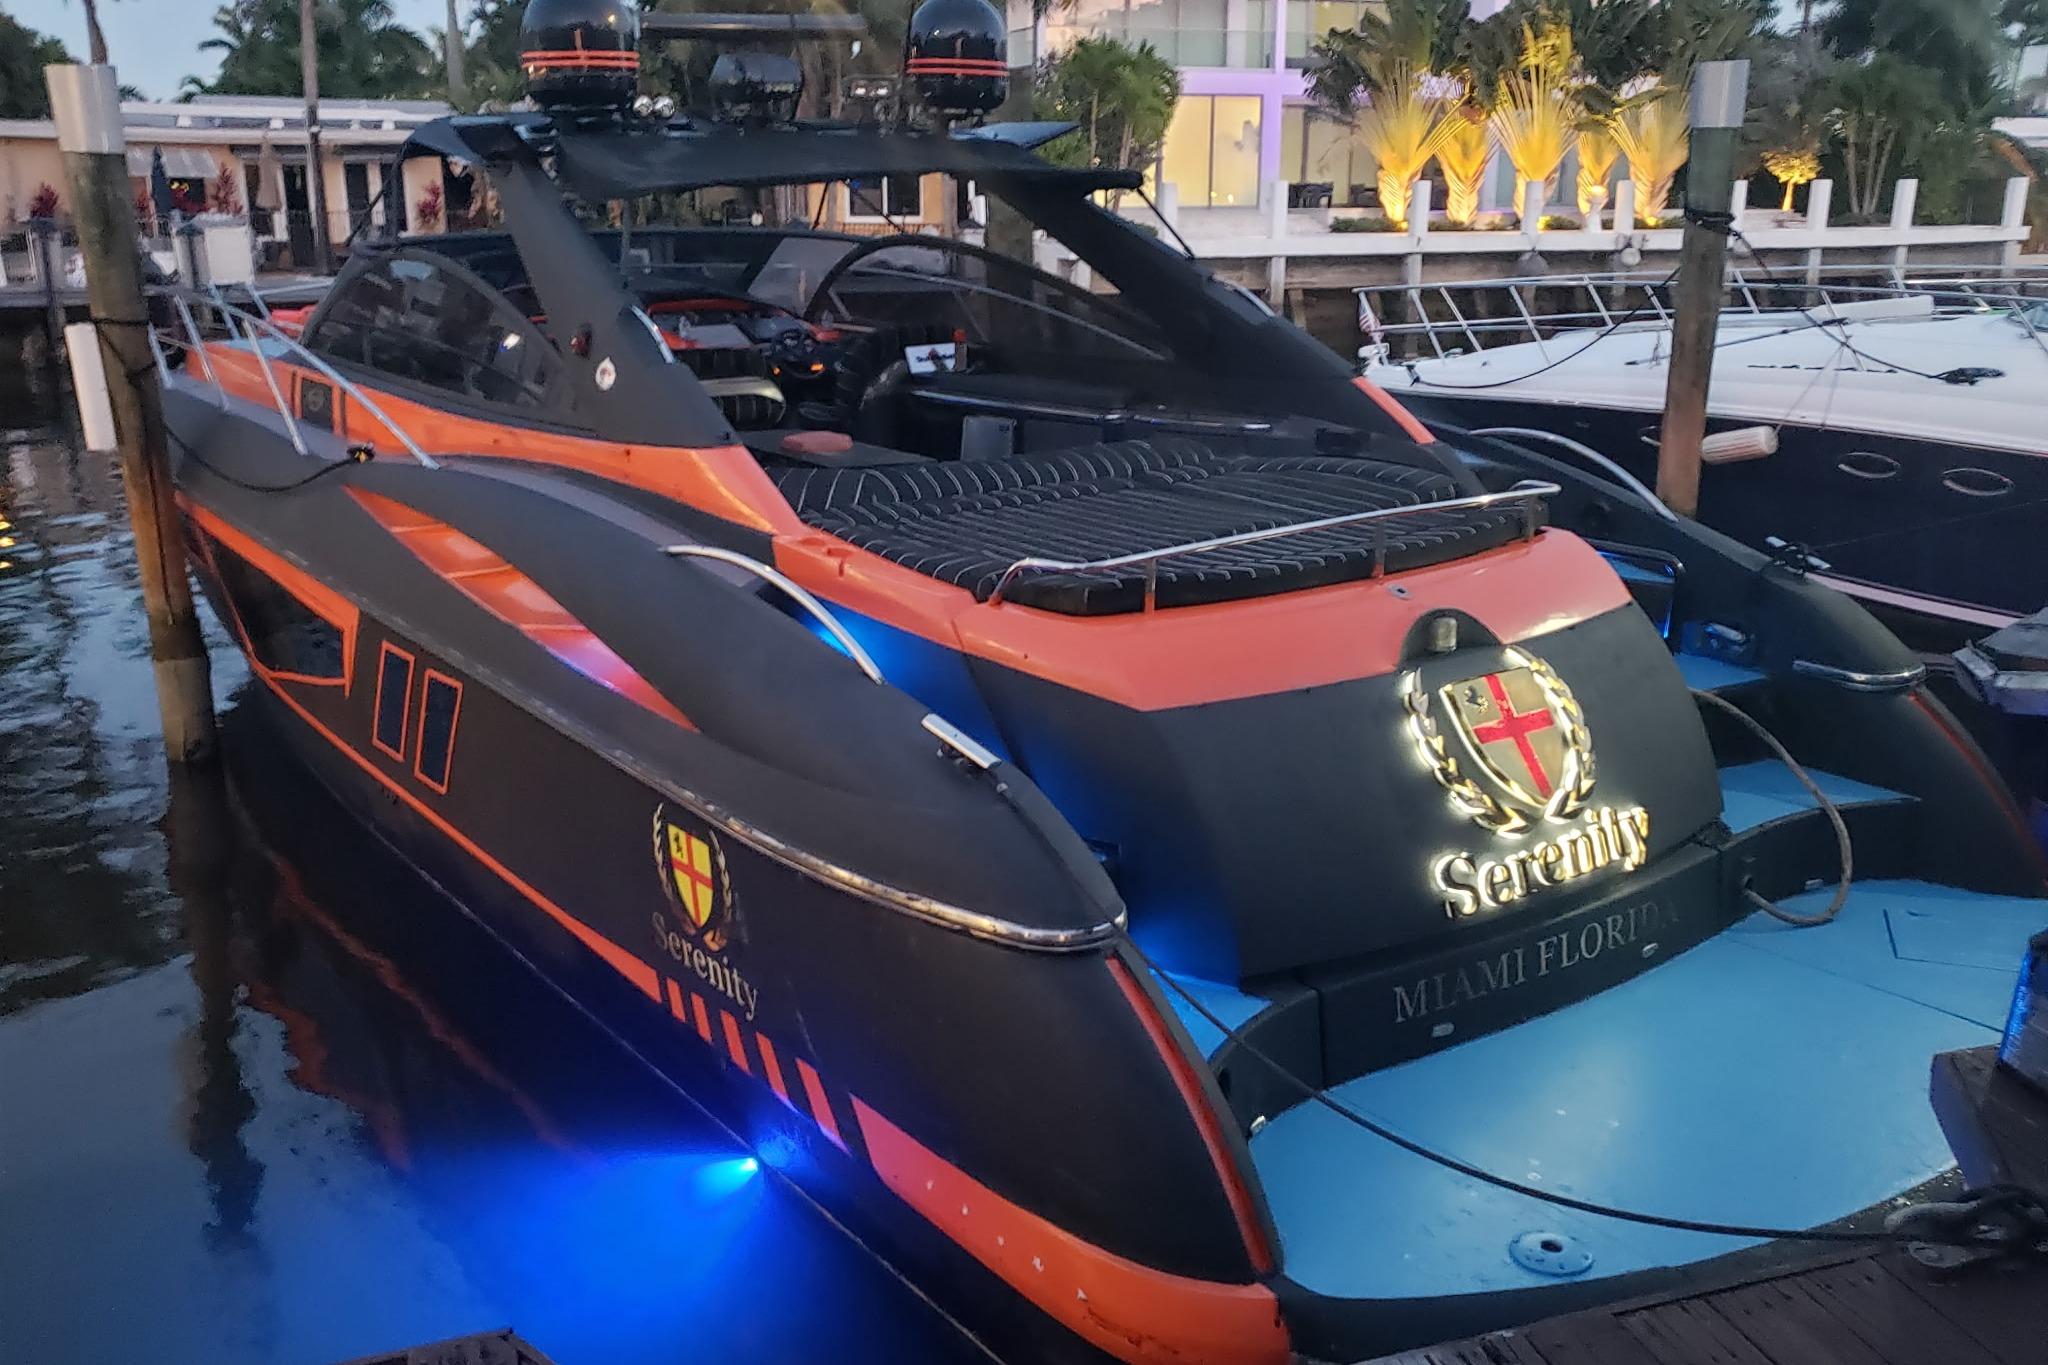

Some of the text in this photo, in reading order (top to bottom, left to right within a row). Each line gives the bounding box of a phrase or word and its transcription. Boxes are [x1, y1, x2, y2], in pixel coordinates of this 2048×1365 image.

[1432, 805, 1649, 919] Serenity
[651, 912, 758, 1020] Serenity
[1393, 948, 1526, 1023] MIAMI
